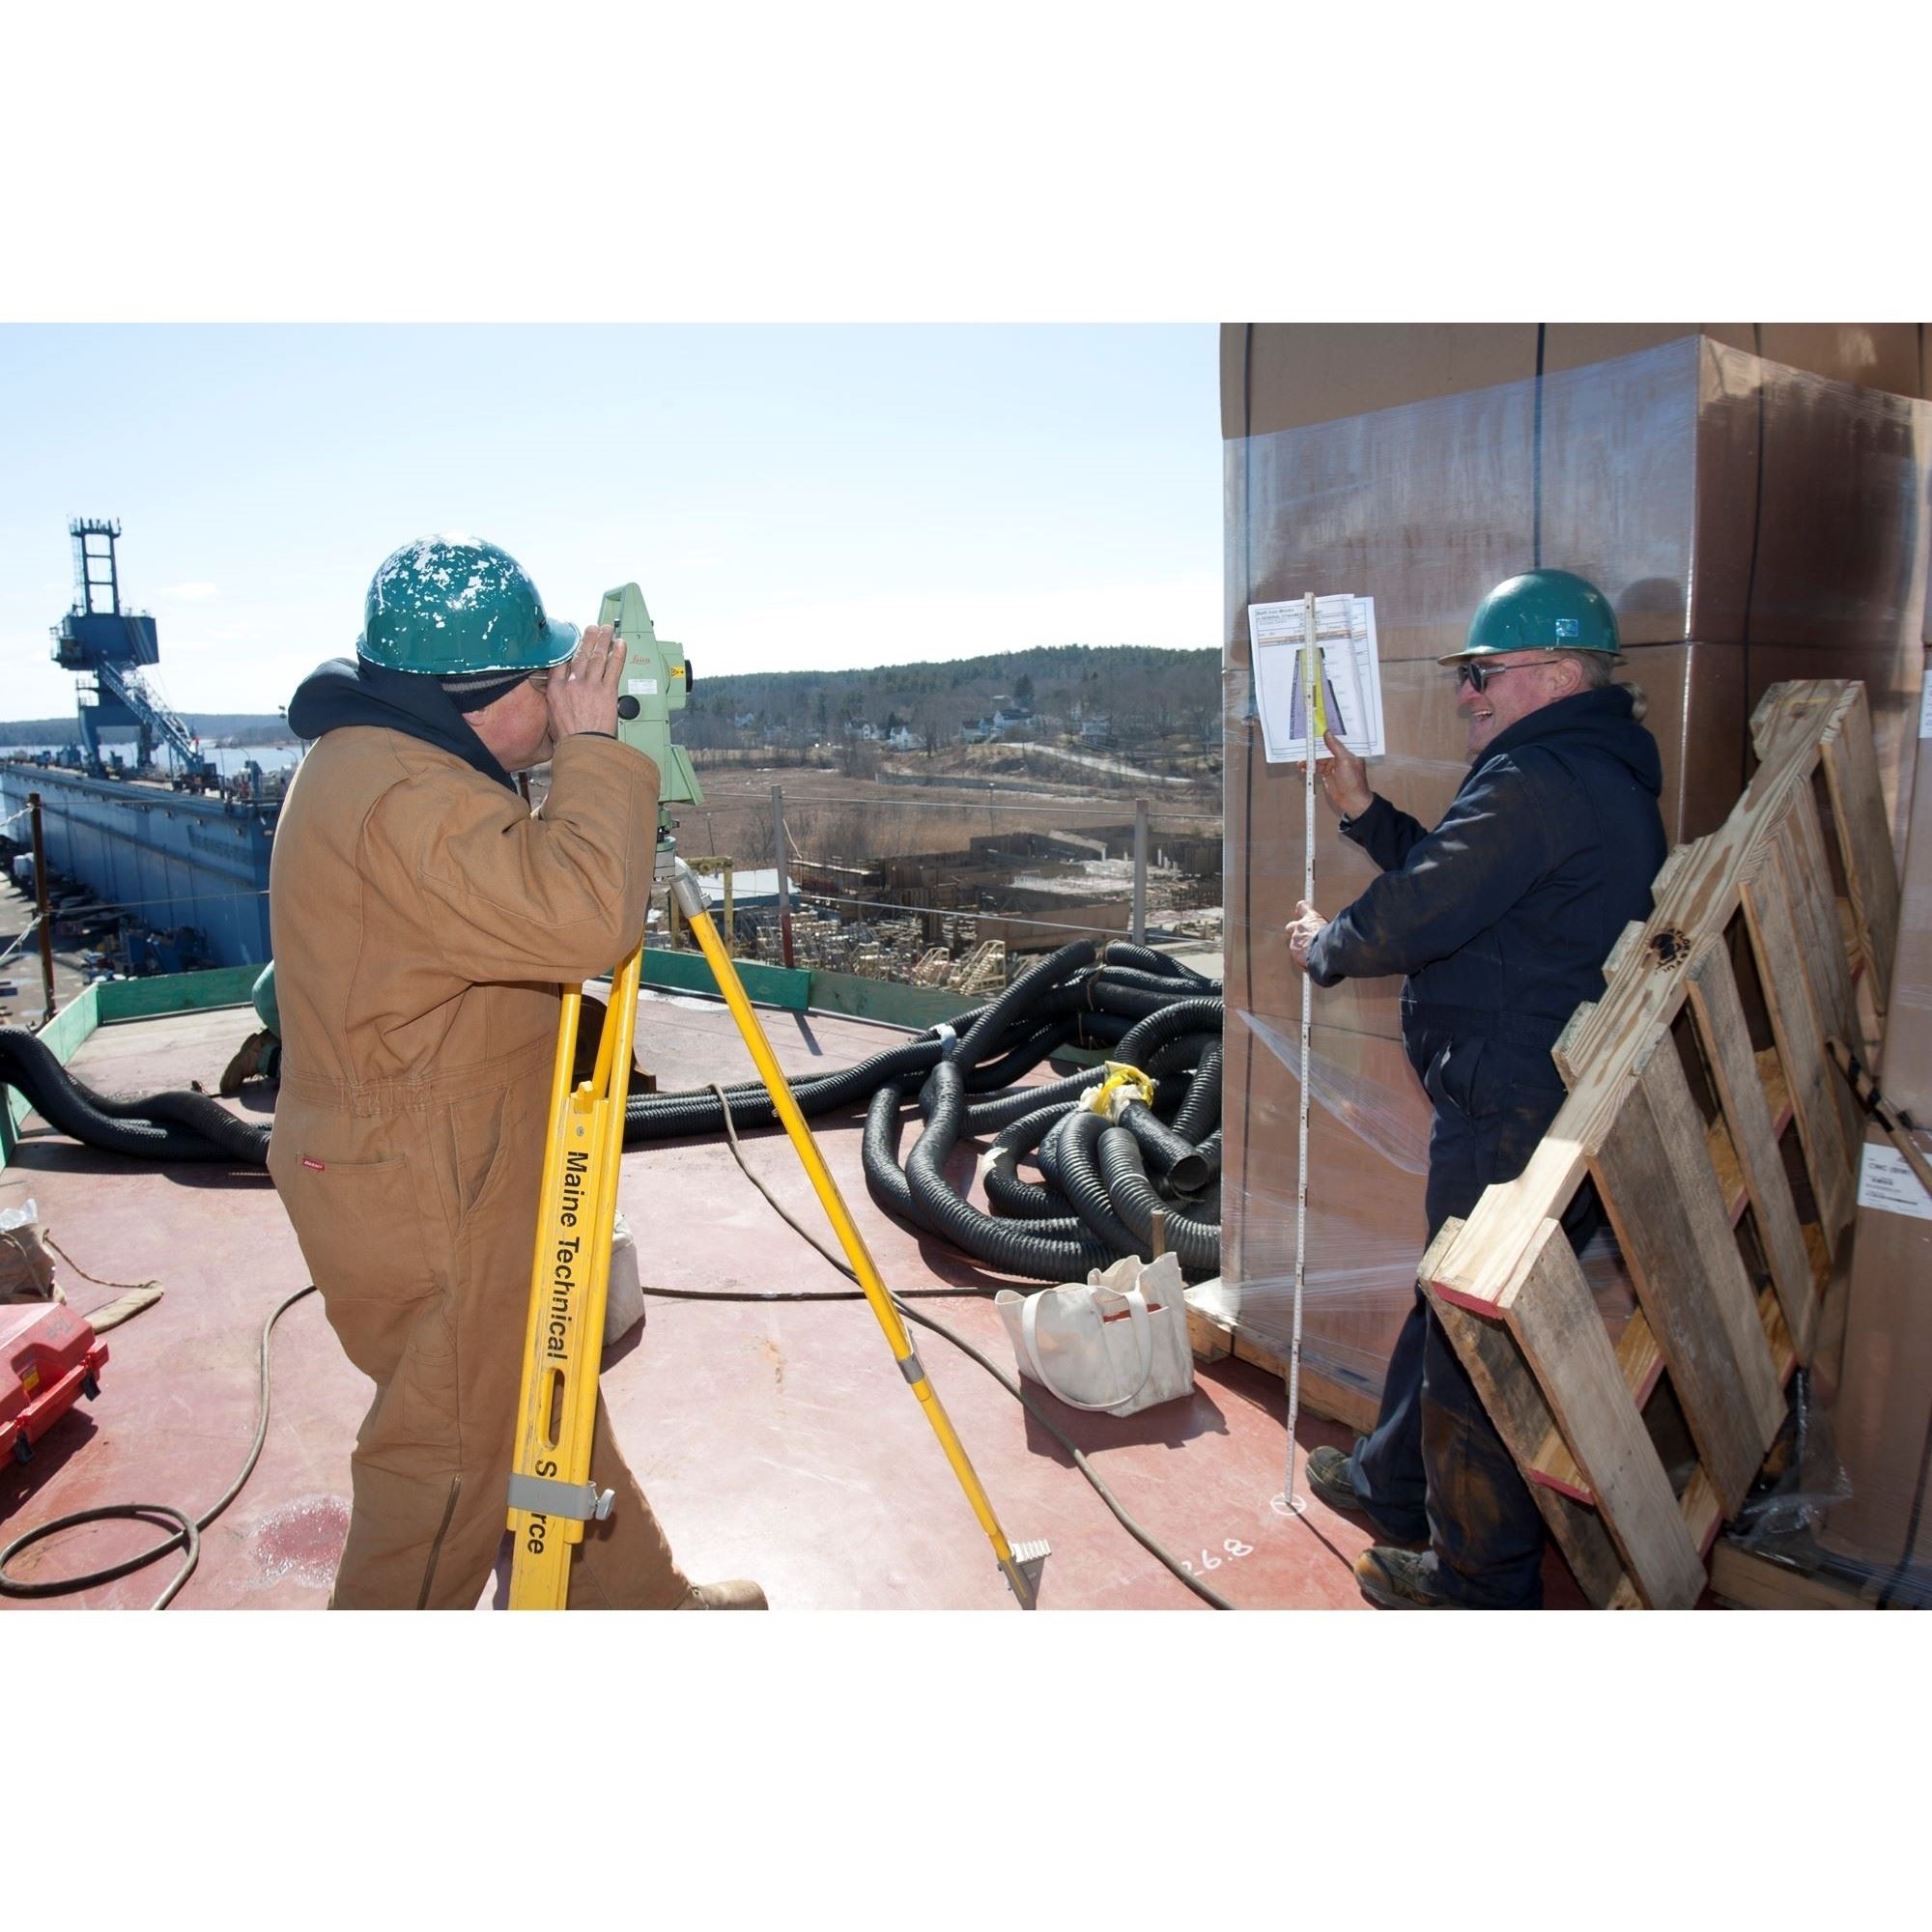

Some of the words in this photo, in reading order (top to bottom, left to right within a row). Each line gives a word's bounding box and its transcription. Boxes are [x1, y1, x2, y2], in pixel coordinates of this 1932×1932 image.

[631, 655, 650, 665] Leica
[560, 1151, 589, 1228] Maine
[547, 1236, 581, 1360] Technical
[526, 1460, 557, 1554] Srce
